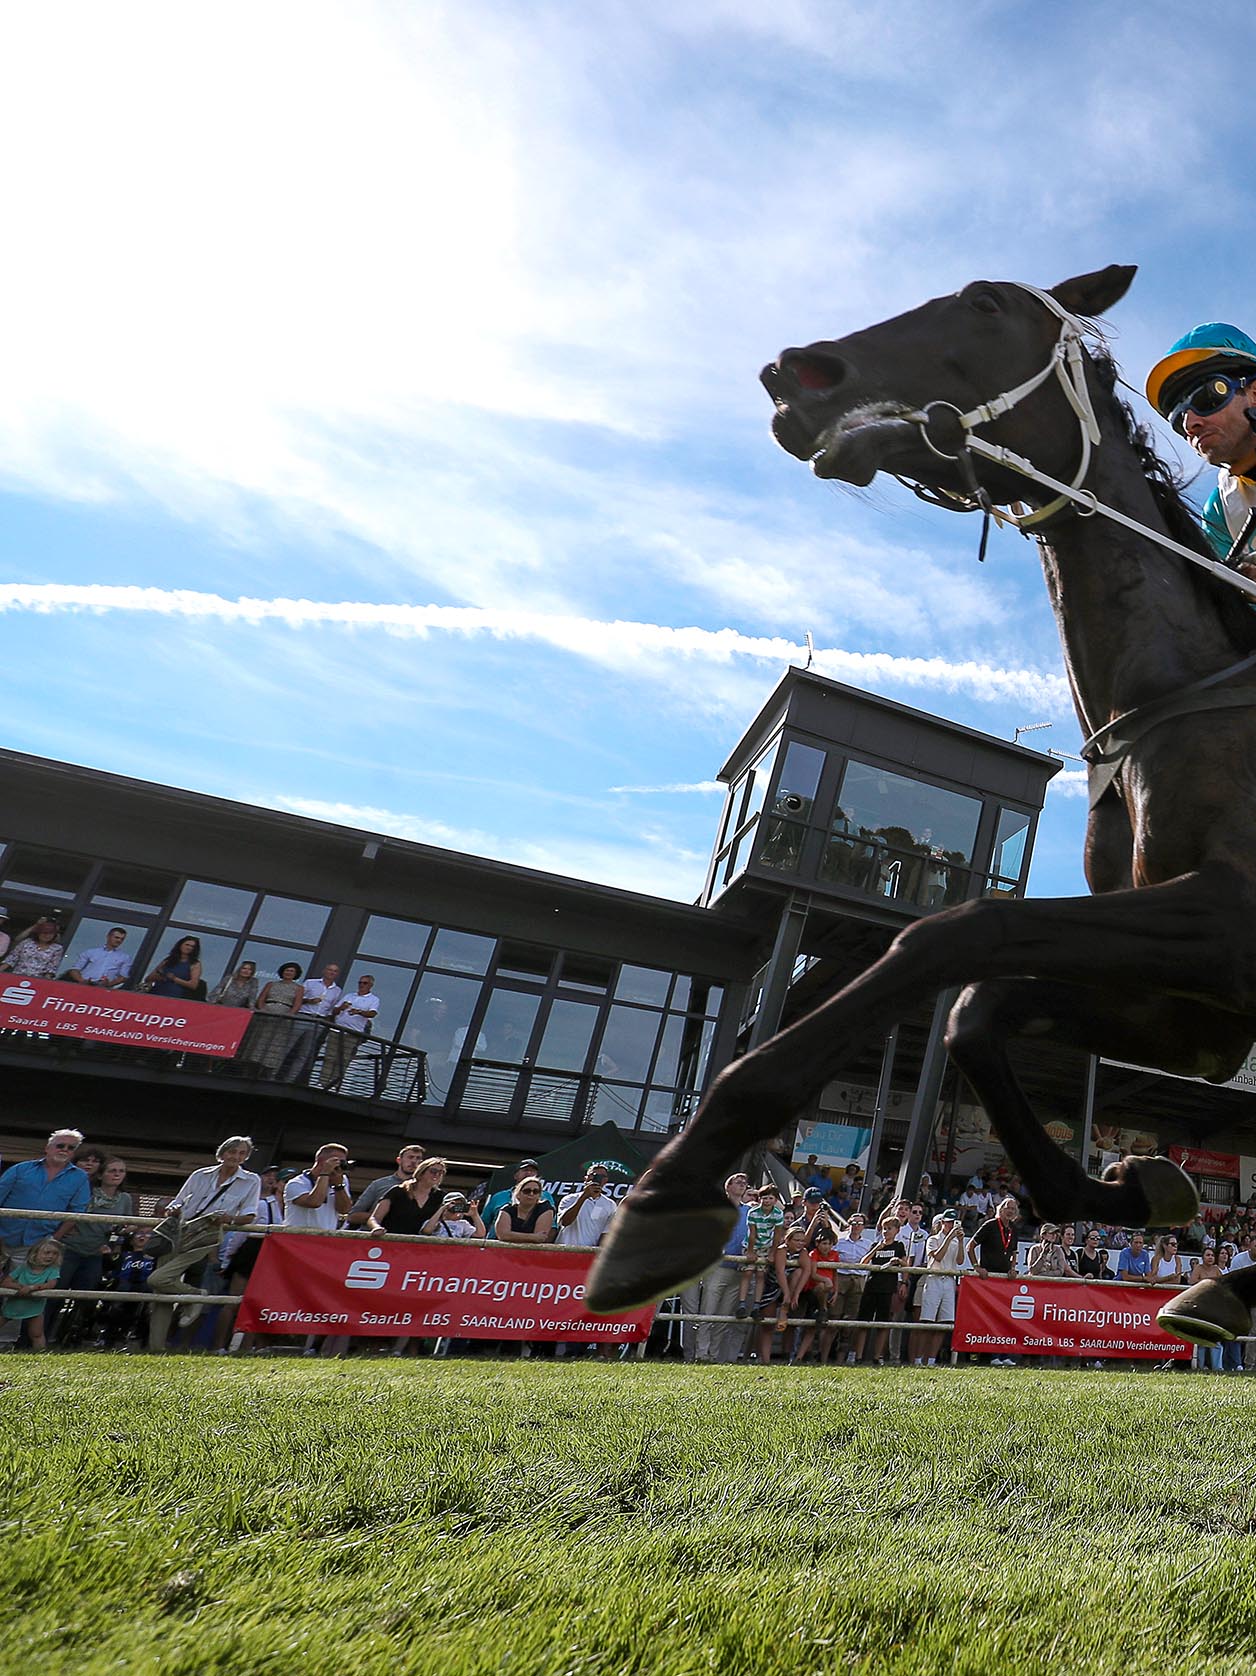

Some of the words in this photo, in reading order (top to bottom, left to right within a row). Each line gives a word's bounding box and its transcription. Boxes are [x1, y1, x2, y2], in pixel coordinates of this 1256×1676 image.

[41, 996, 188, 1028] Finanzgruppe
[8, 1015, 49, 1028] SaarLB
[56, 1022, 78, 1031] LBS
[84, 1026, 143, 1040] SAARLAND
[146, 1033, 225, 1051] Versicherungen
[401, 1271, 587, 1304] Finanzgruppe
[259, 1308, 349, 1324] Sparkassen
[359, 1311, 412, 1325] SaarLB
[422, 1313, 451, 1326] LBS
[460, 1314, 535, 1330] SAARLAND
[539, 1318, 637, 1335] Versicherungen
[1042, 1303, 1151, 1329] Finanzgruppe
[965, 1333, 1017, 1345] Sparkassen
[1023, 1335, 1053, 1347] SaarLB
[1059, 1338, 1074, 1348] LBS
[1080, 1338, 1125, 1350] SAARLAND
[1126, 1340, 1185, 1353] Versicherungen
